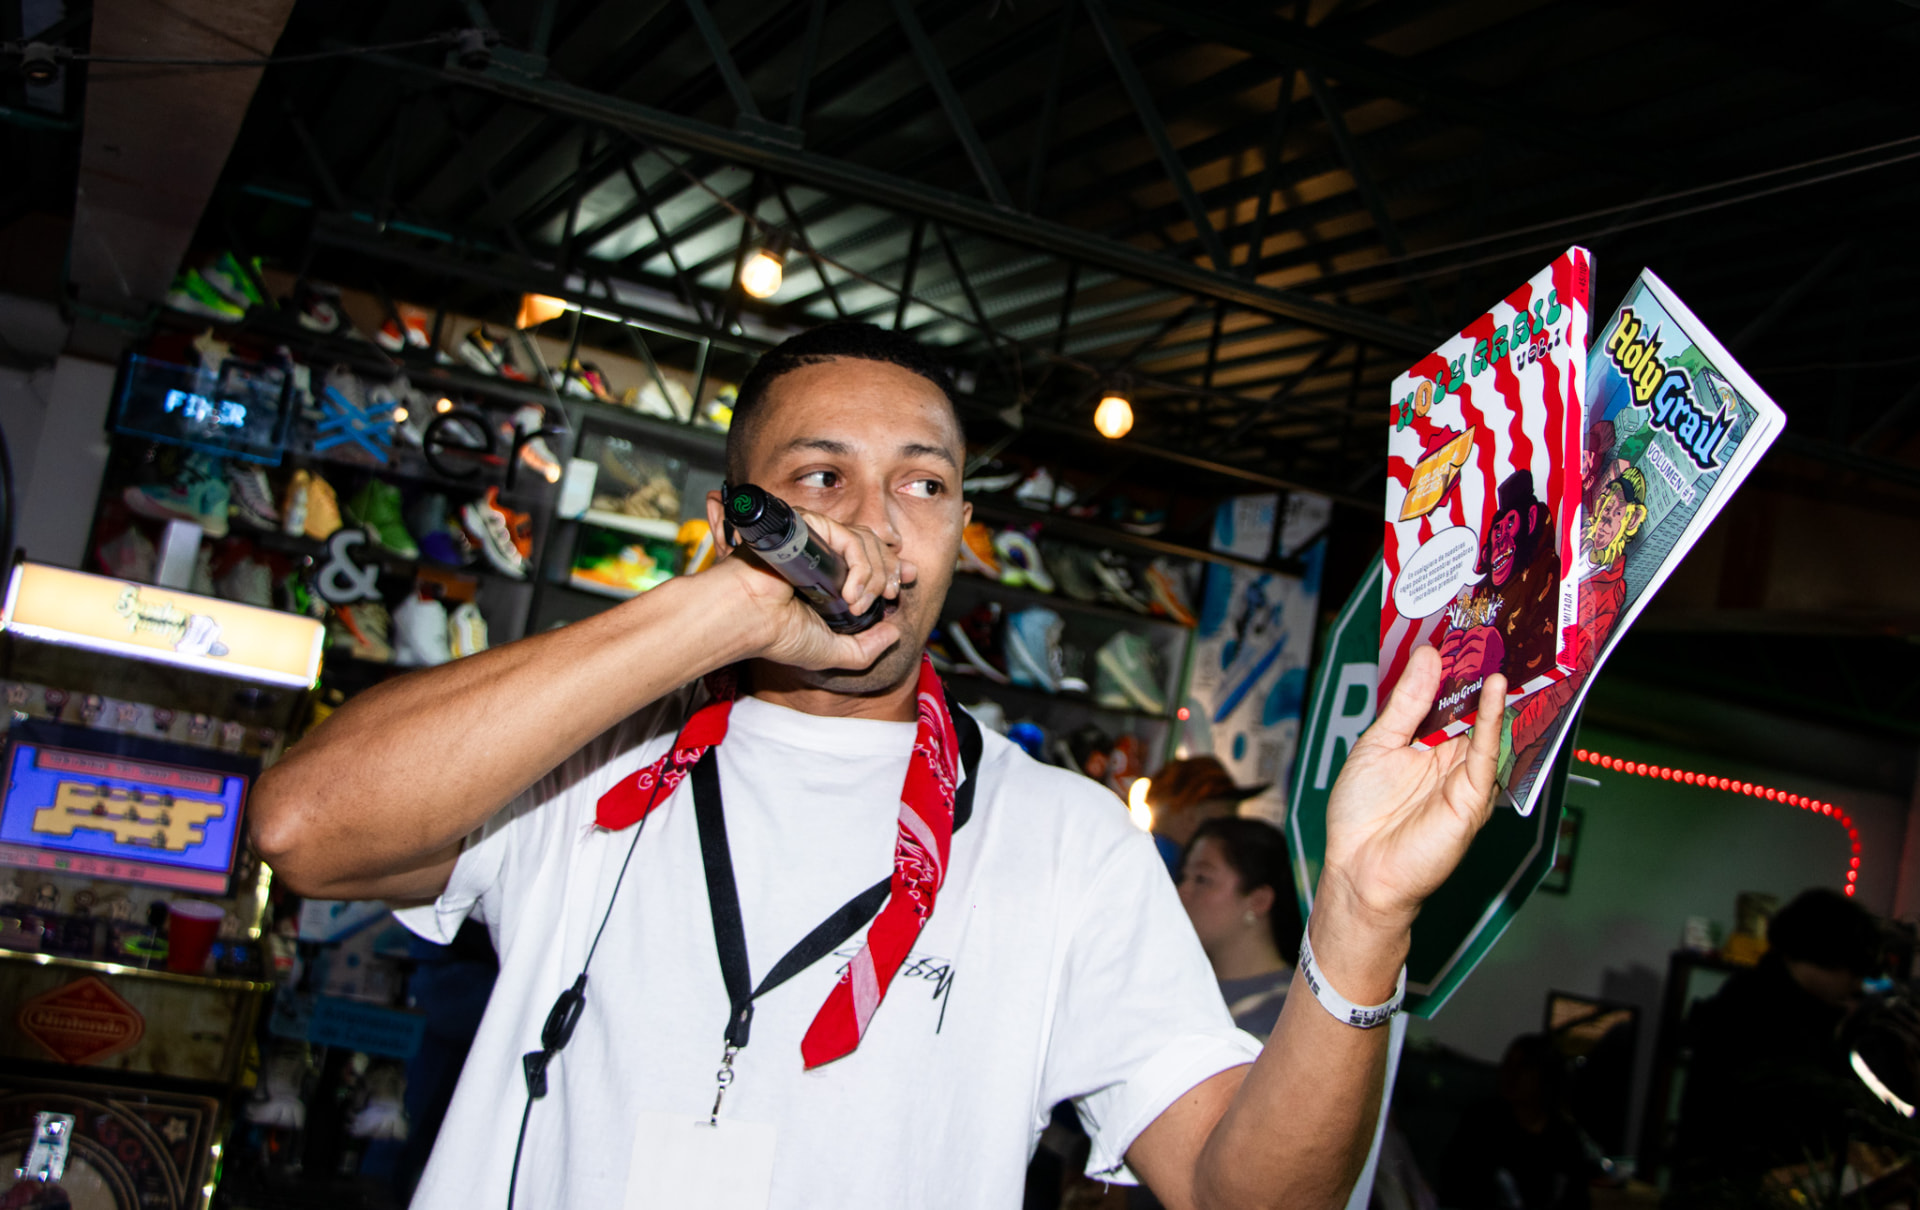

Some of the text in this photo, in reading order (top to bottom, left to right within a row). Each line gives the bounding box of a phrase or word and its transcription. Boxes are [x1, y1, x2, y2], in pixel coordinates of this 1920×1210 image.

[1396, 288, 1562, 432] HOLY GRAIL
[1606, 309, 1731, 467] Holy Grail
[1648, 444, 1695, 501] VOLUMEN #1
[1562, 593, 1573, 630] LIMITADA
[1438, 676, 1483, 711] Holy Grail
